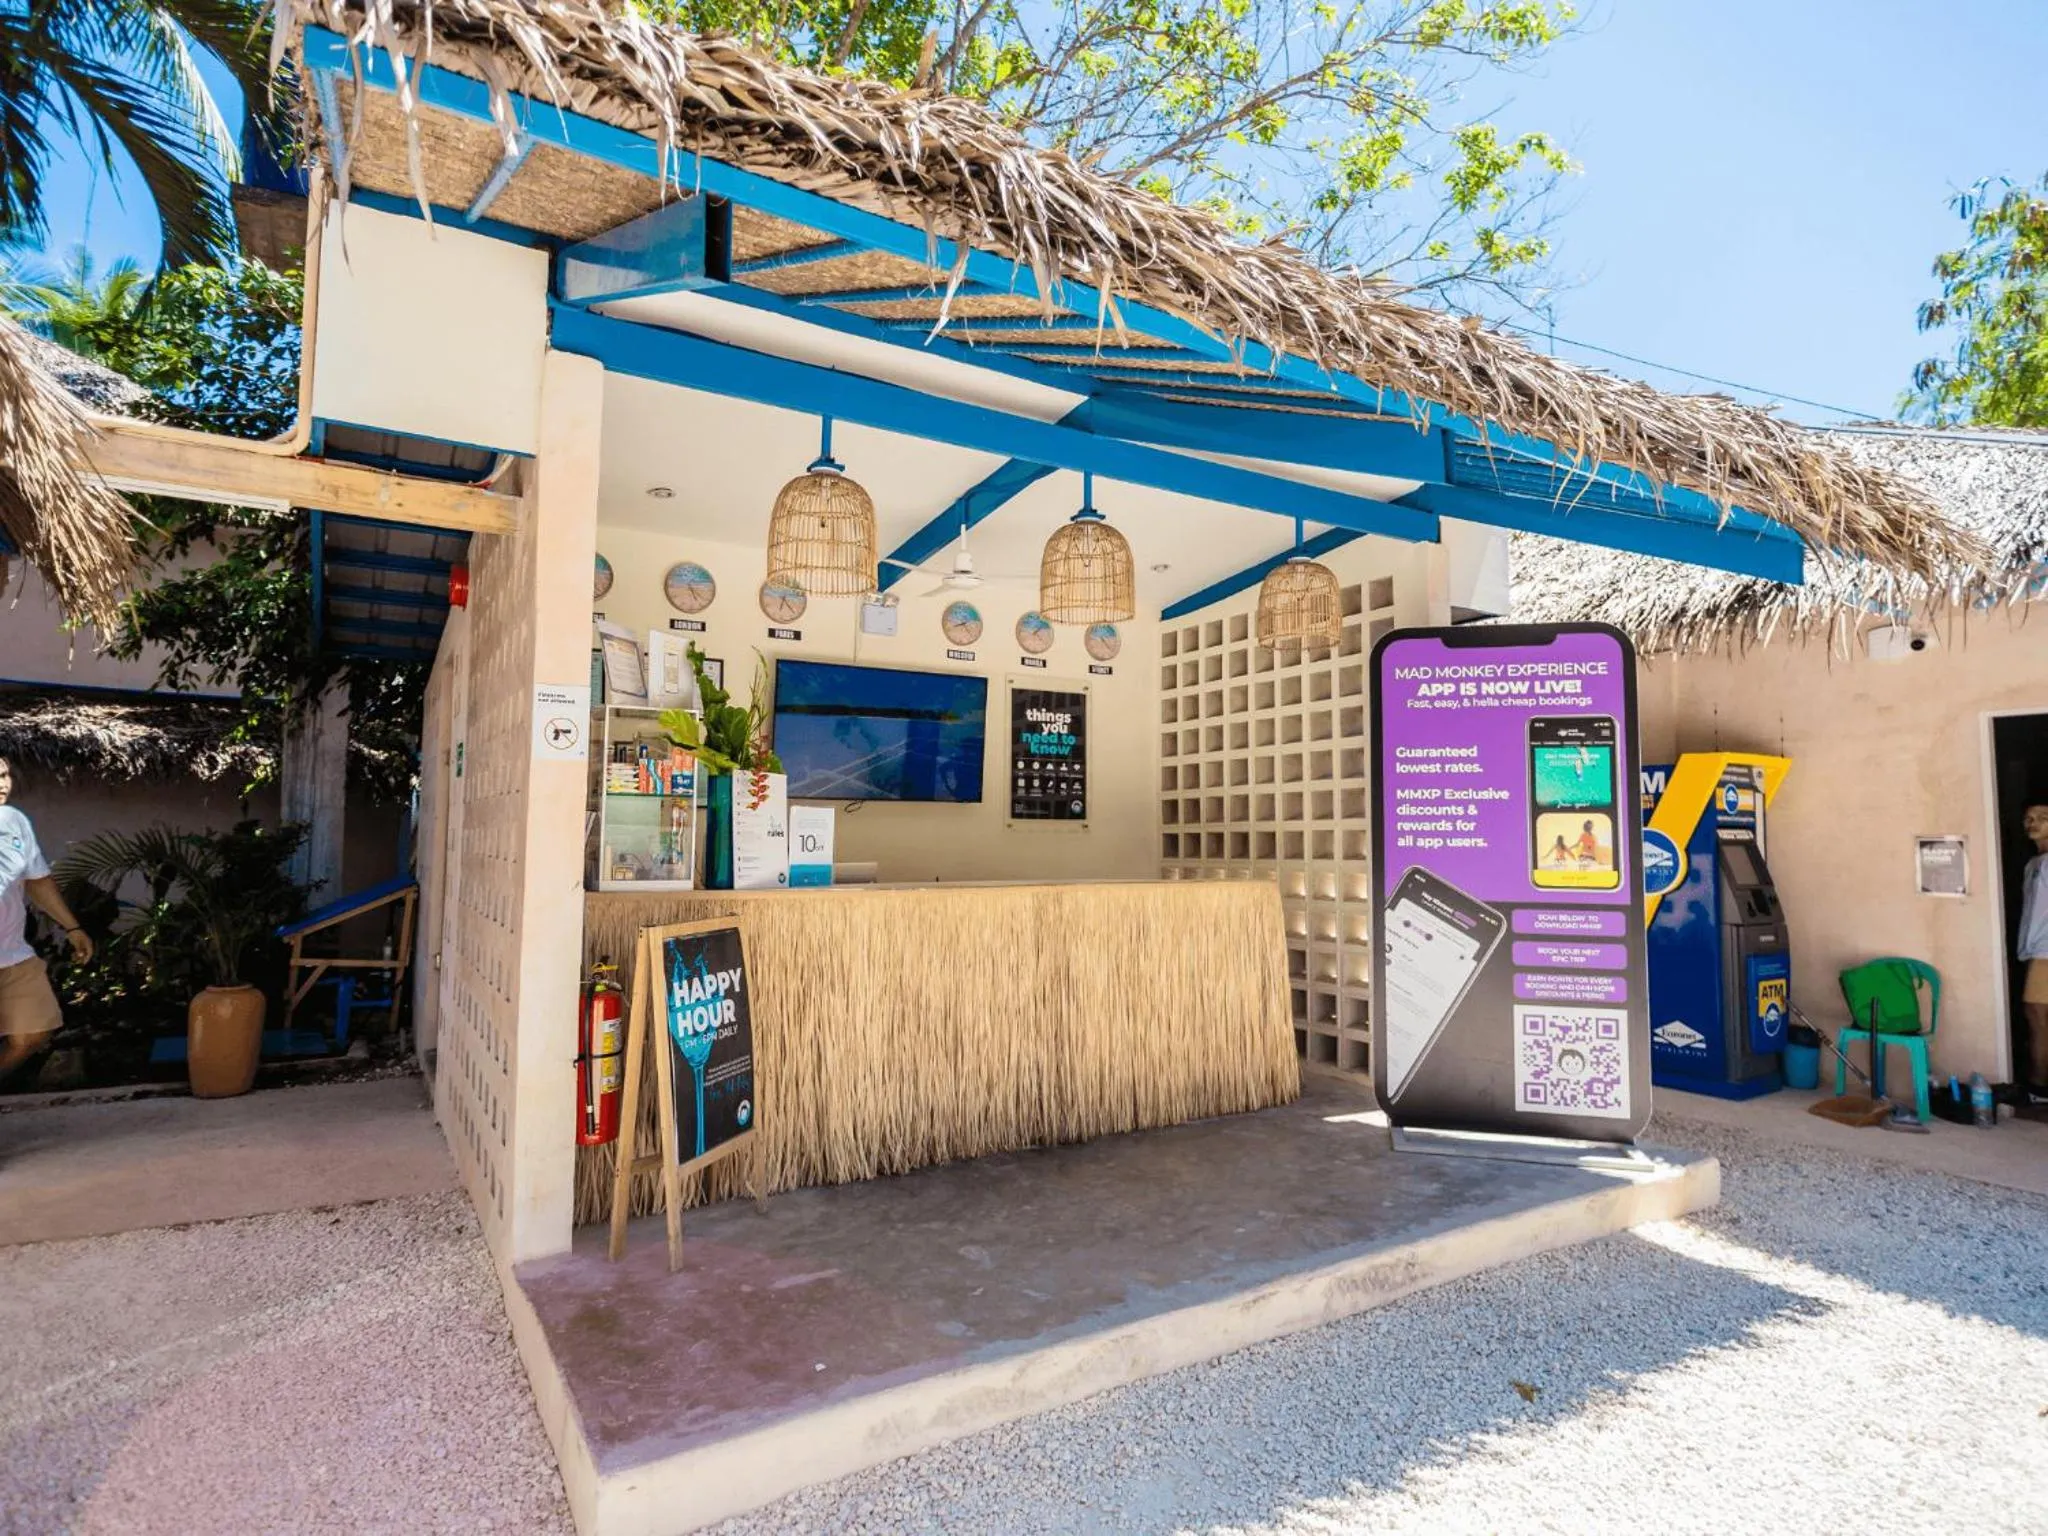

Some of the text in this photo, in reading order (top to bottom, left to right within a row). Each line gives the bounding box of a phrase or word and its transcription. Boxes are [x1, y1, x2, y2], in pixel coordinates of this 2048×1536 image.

[1395, 662, 1608, 679] MAD MONKEY EXPERIENCE
[1417, 680, 1582, 697] APP IS NOW LIVE!
[1407, 695, 1592, 710] Fast, easy, & hella cheap bookings
[1025, 708, 1072, 724] things
[1042, 722, 1068, 735] you
[1021, 732, 1076, 745] need to
[1030, 743, 1072, 755] know
[1396, 745, 1478, 758] Guaranteed
[1396, 762, 1483, 773] lowest rates.
[1397, 787, 1510, 799] MMXP Exclusive
[1396, 804, 1478, 815] discounts &
[1397, 820, 1476, 831] rewards for
[1397, 836, 1488, 848] all app users.
[673, 968, 742, 1008] HAPPY
[1762, 984, 1783, 999] ATM
[677, 999, 736, 1038] HOUR
[719, 1024, 738, 1039] DAILY
